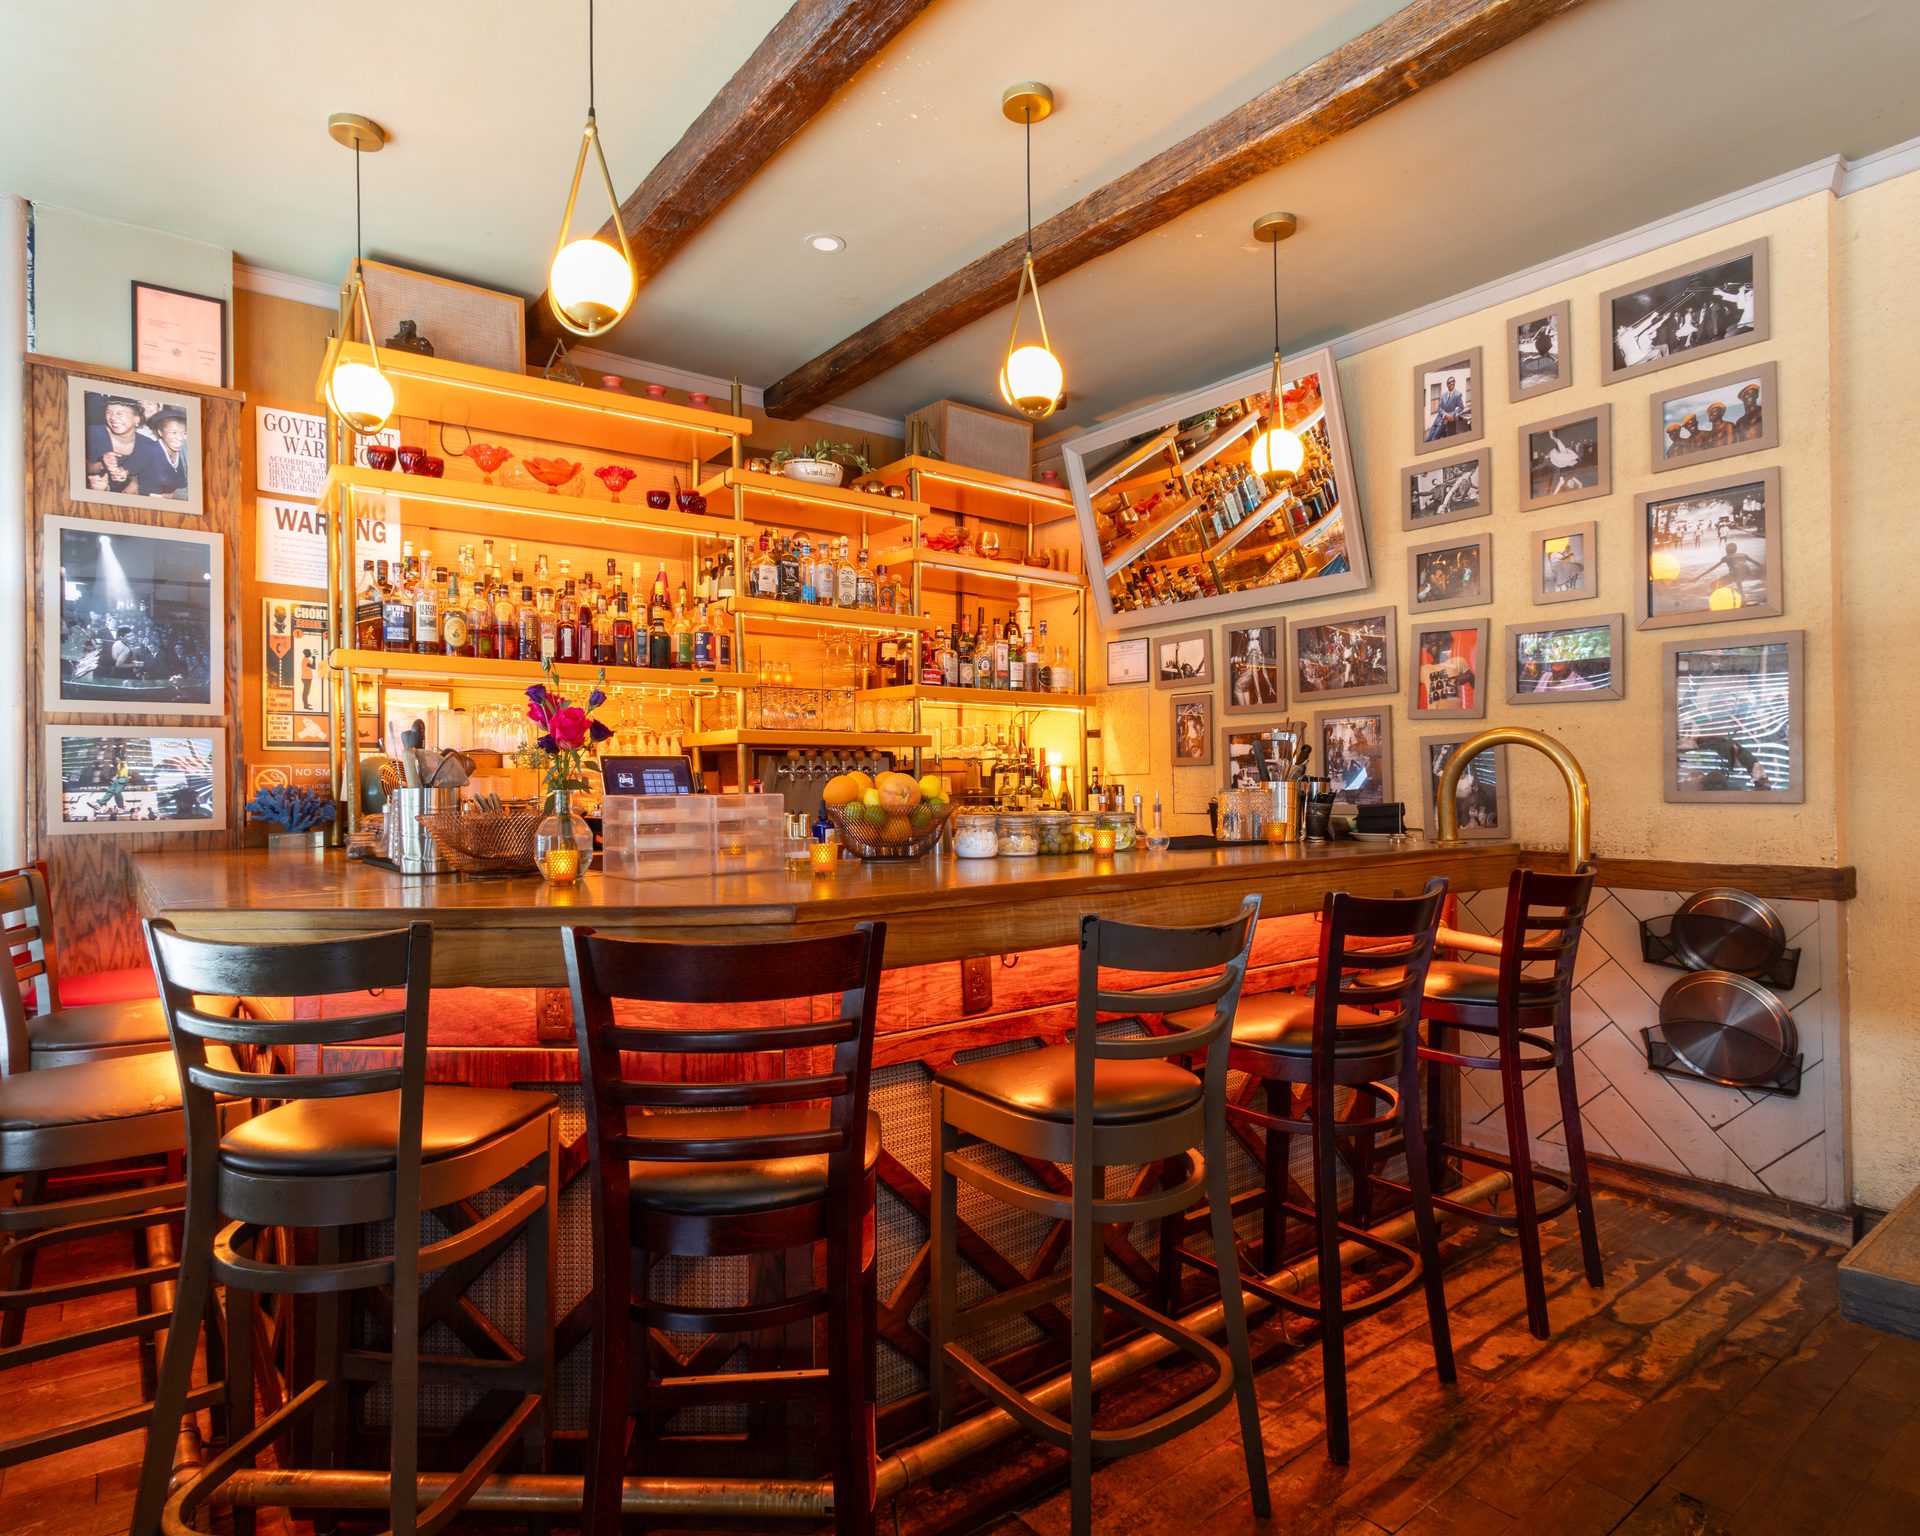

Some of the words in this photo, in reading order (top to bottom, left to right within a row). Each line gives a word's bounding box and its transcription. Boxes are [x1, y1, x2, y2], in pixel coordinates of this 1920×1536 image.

[264, 413, 394, 447] GOVERENT
[283, 435, 370, 466] WARG
[299, 473, 327, 482] ALCOH
[275, 507, 386, 543] WARNG
[294, 607, 327, 620] CHOKI
[295, 768, 312, 777] NO
